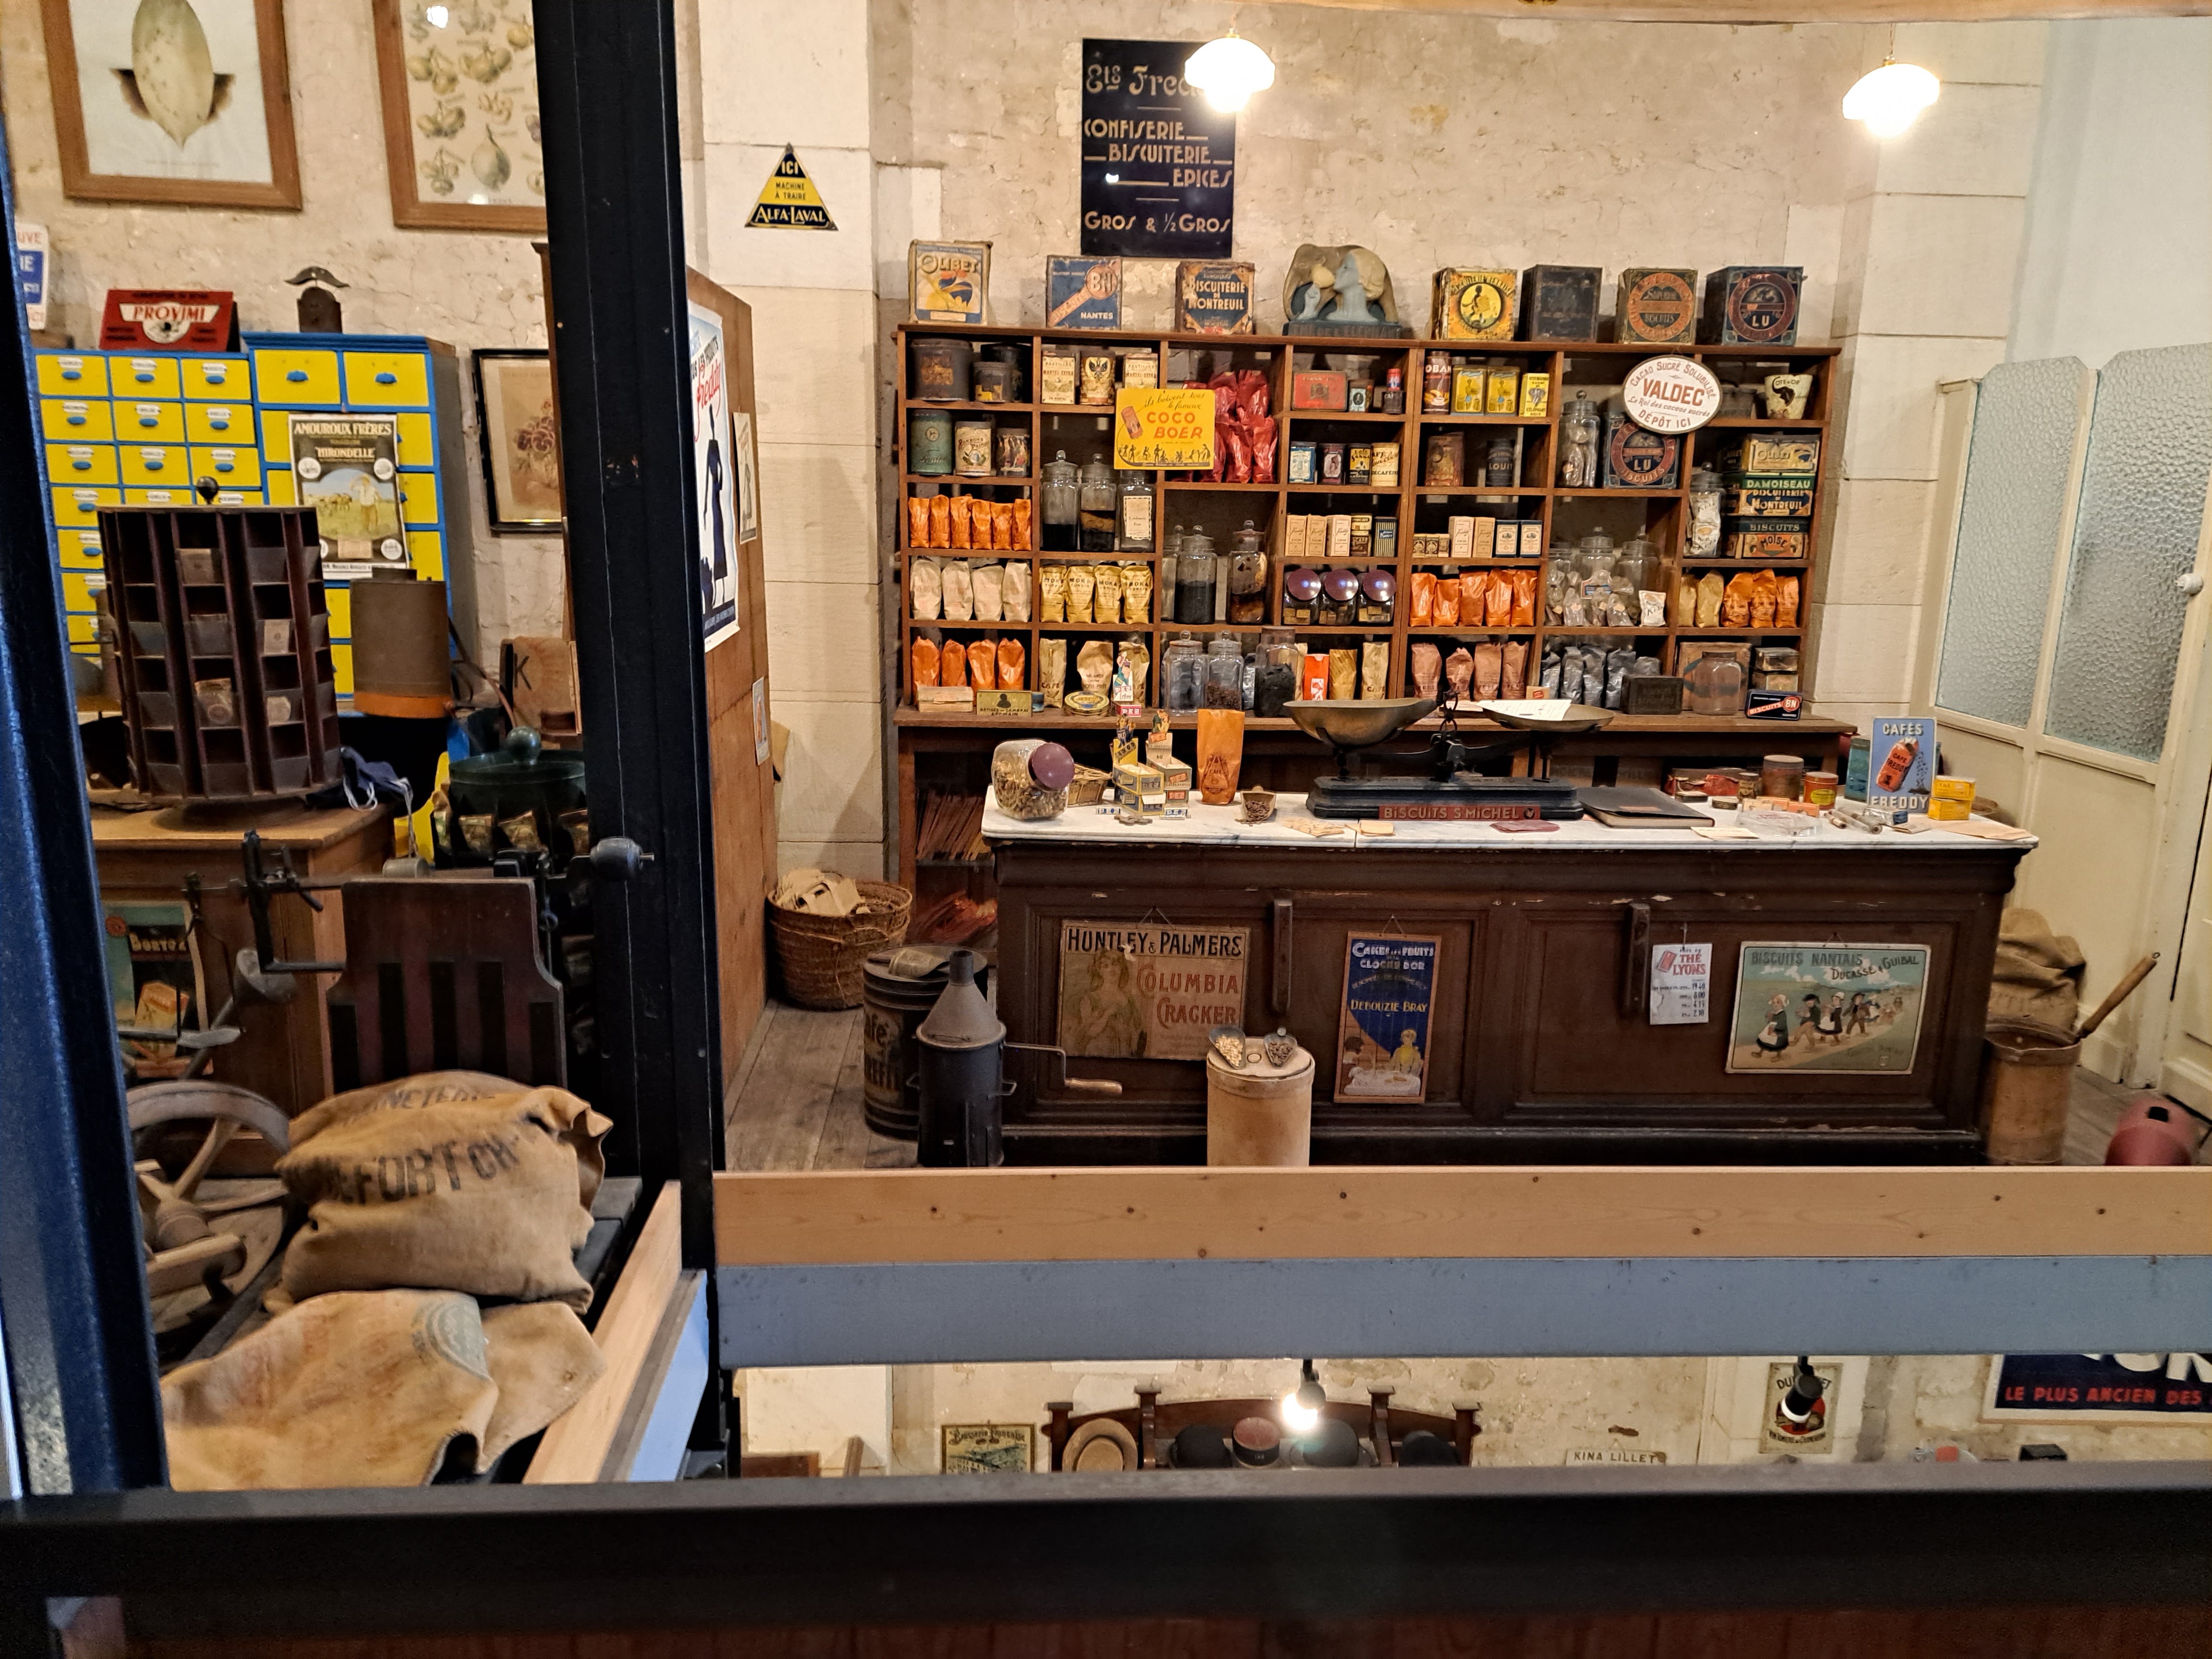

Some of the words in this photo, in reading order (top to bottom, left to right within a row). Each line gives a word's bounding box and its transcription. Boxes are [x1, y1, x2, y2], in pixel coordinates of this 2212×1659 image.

[1084, 119, 1185, 140] CONFISERIE
[1109, 144, 1211, 164] BISCUITERIE
[781, 161, 798, 174] ICI
[775, 181, 805, 190] MACHINE
[784, 192, 806, 200] TRAIRE
[1146, 219, 1156, 232] &
[921, 255, 979, 274] OLIBET
[1090, 272, 1113, 292] BN
[1189, 276, 1245, 293] BISCUITERIE
[134, 306, 205, 321] PROVIMI
[1752, 315, 1770, 327] LU
[1631, 366, 1653, 387] CACAO
[1657, 361, 1681, 371] SUCRÉ
[1683, 362, 1716, 399] SOLUBILISÉ
[1643, 378, 1705, 407] VALDEC
[1144, 396, 1154, 408] ils
[1157, 392, 1185, 403] boivent
[1174, 401, 1202, 411] fameux
[1650, 400, 1662, 408] des
[1663, 404, 1687, 413] cacaos
[1688, 409, 1711, 417] sucrés
[1146, 411, 1196, 424] COCO
[1638, 409, 1672, 428] DÉPÔT
[1676, 418, 1692, 429] ICI
[295, 423, 352, 435] AMOUROUX
[1153, 426, 1204, 439] BOER
[1634, 459, 1651, 471] LU
[1619, 466, 1665, 483] BISCUITS
[1747, 480, 1810, 489] DAMOISEAU
[1752, 498, 1803, 510] MONTREUIL
[1761, 535, 1788, 548] MOISE
[1749, 703, 1782, 715] BISCUITS
[1785, 698, 1797, 708] BN
[1883, 722, 1924, 736] CAFÉS
[1870, 796, 1929, 810] FREDDY
[1454, 807, 1462, 819] S
[1067, 928, 1149, 954] HUNTLEY
[1160, 931, 1242, 957] PALMERS
[1352, 942, 1390, 958] CAKES
[1402, 946, 1434, 957] FRUITS
[1751, 951, 1803, 966] BISCUITS
[1811, 952, 1863, 967] NANTAIS
[1673, 963, 1706, 976] LYONS
[1137, 964, 1239, 999] COLUMBIA
[1157, 997, 1237, 1029] CRACKER
[1403, 1001, 1428, 1014] BRAY
[2004, 1386, 2025, 1402] LE
[2034, 1387, 2079, 1403] PLUS
[2086, 1387, 2156, 1404] ANCIEN
[2166, 1389, 2201, 1406] DES
[1574, 1452, 1603, 1460] KINA
[1611, 1452, 1658, 1464] LILLET
